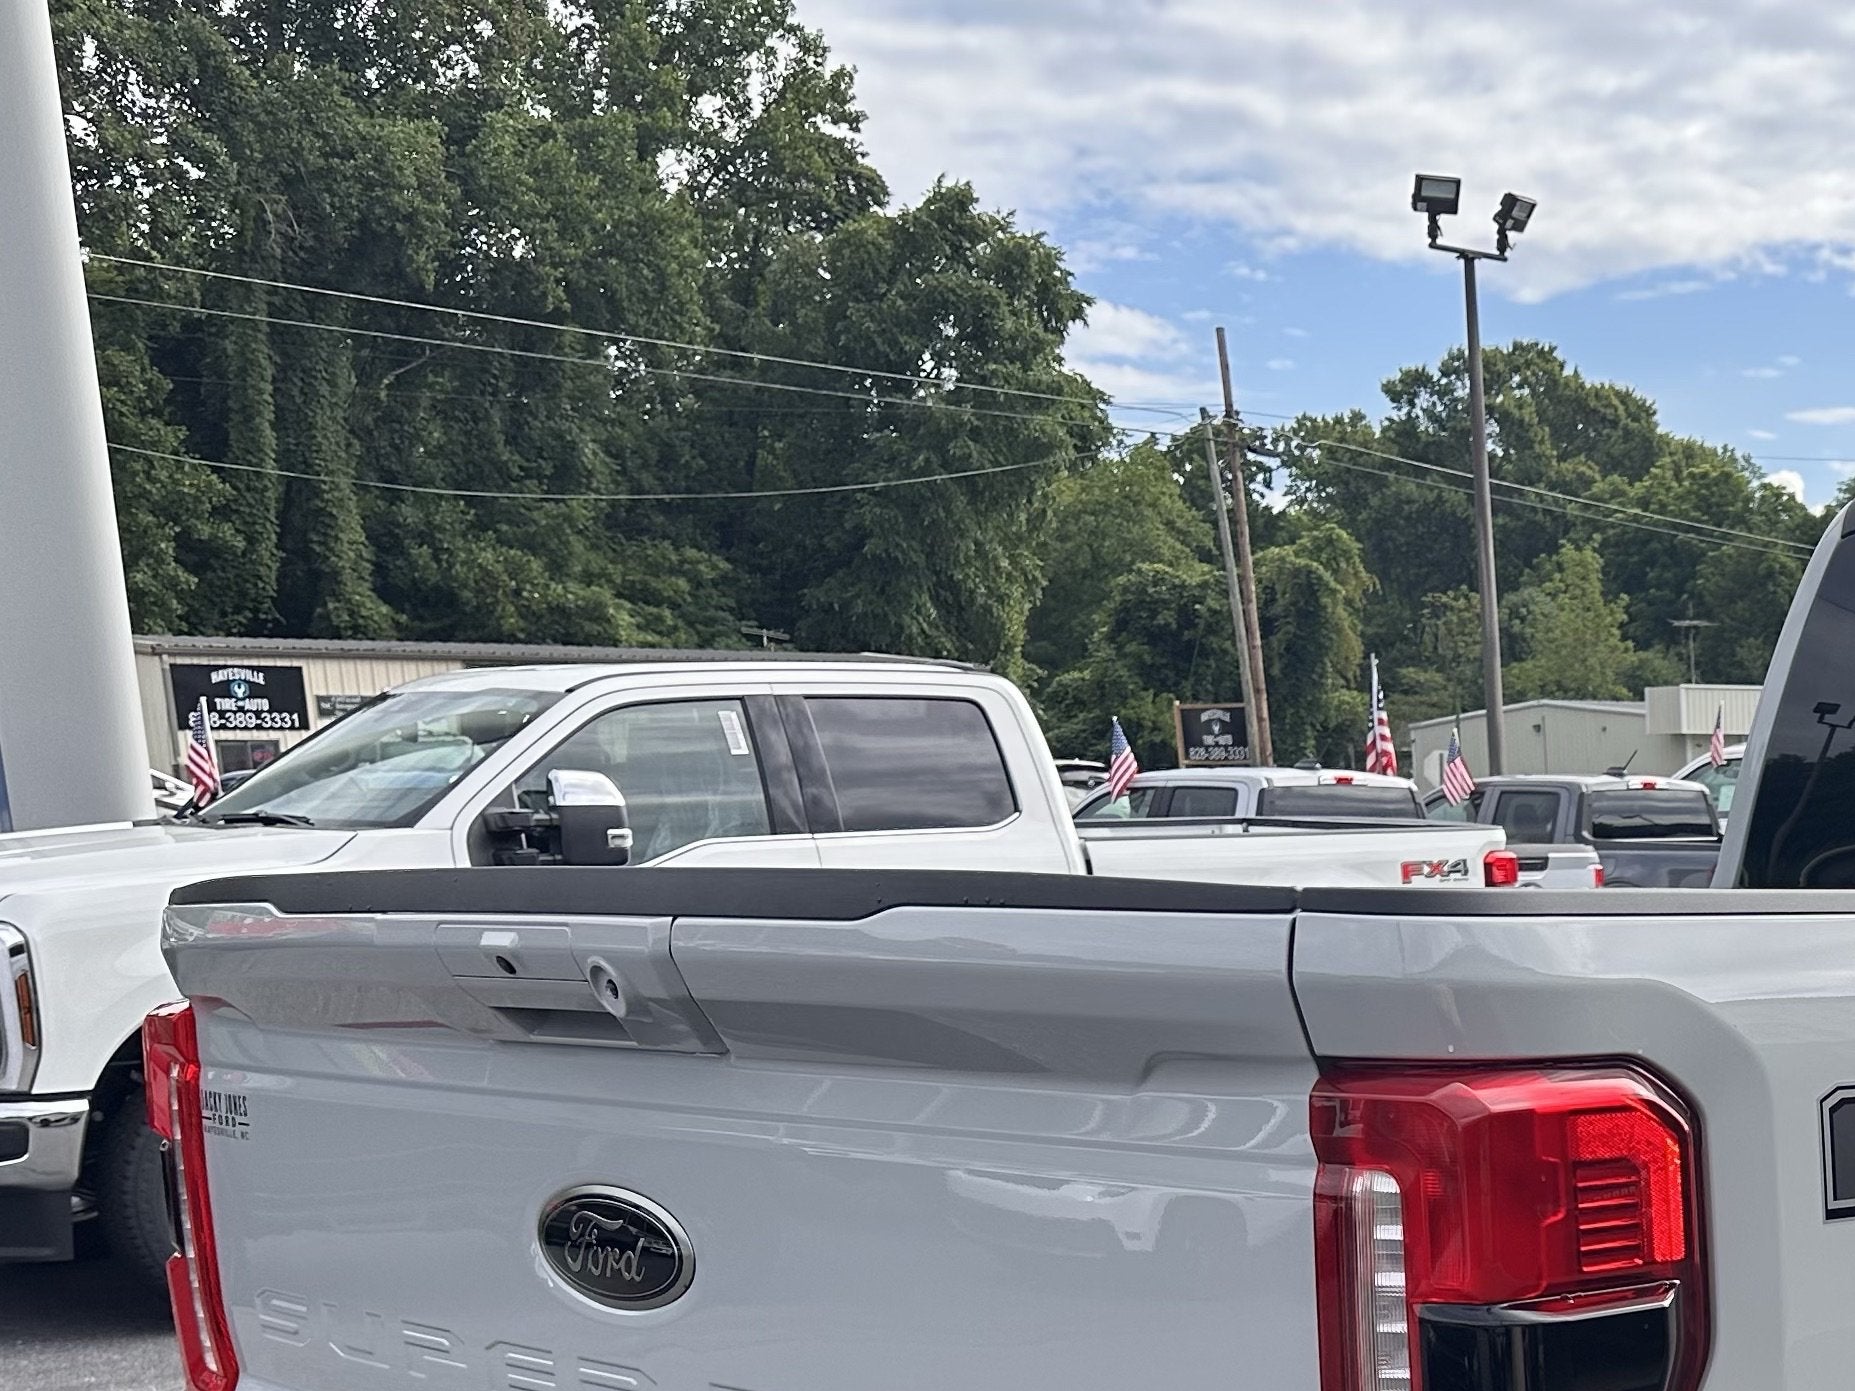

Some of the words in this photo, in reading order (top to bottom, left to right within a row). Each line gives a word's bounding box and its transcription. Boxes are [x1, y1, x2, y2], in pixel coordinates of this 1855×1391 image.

[210, 667, 265, 685] HAYESVILLE
[214, 697, 238, 710] TIRE
[244, 698, 270, 711] AUTO
[188, 711, 300, 728] 88-389-3331
[1401, 859, 1469, 884] FX4
[224, 1093, 248, 1117] JONES
[212, 1113, 237, 1127] FORD
[564, 1210, 645, 1282] Ford
